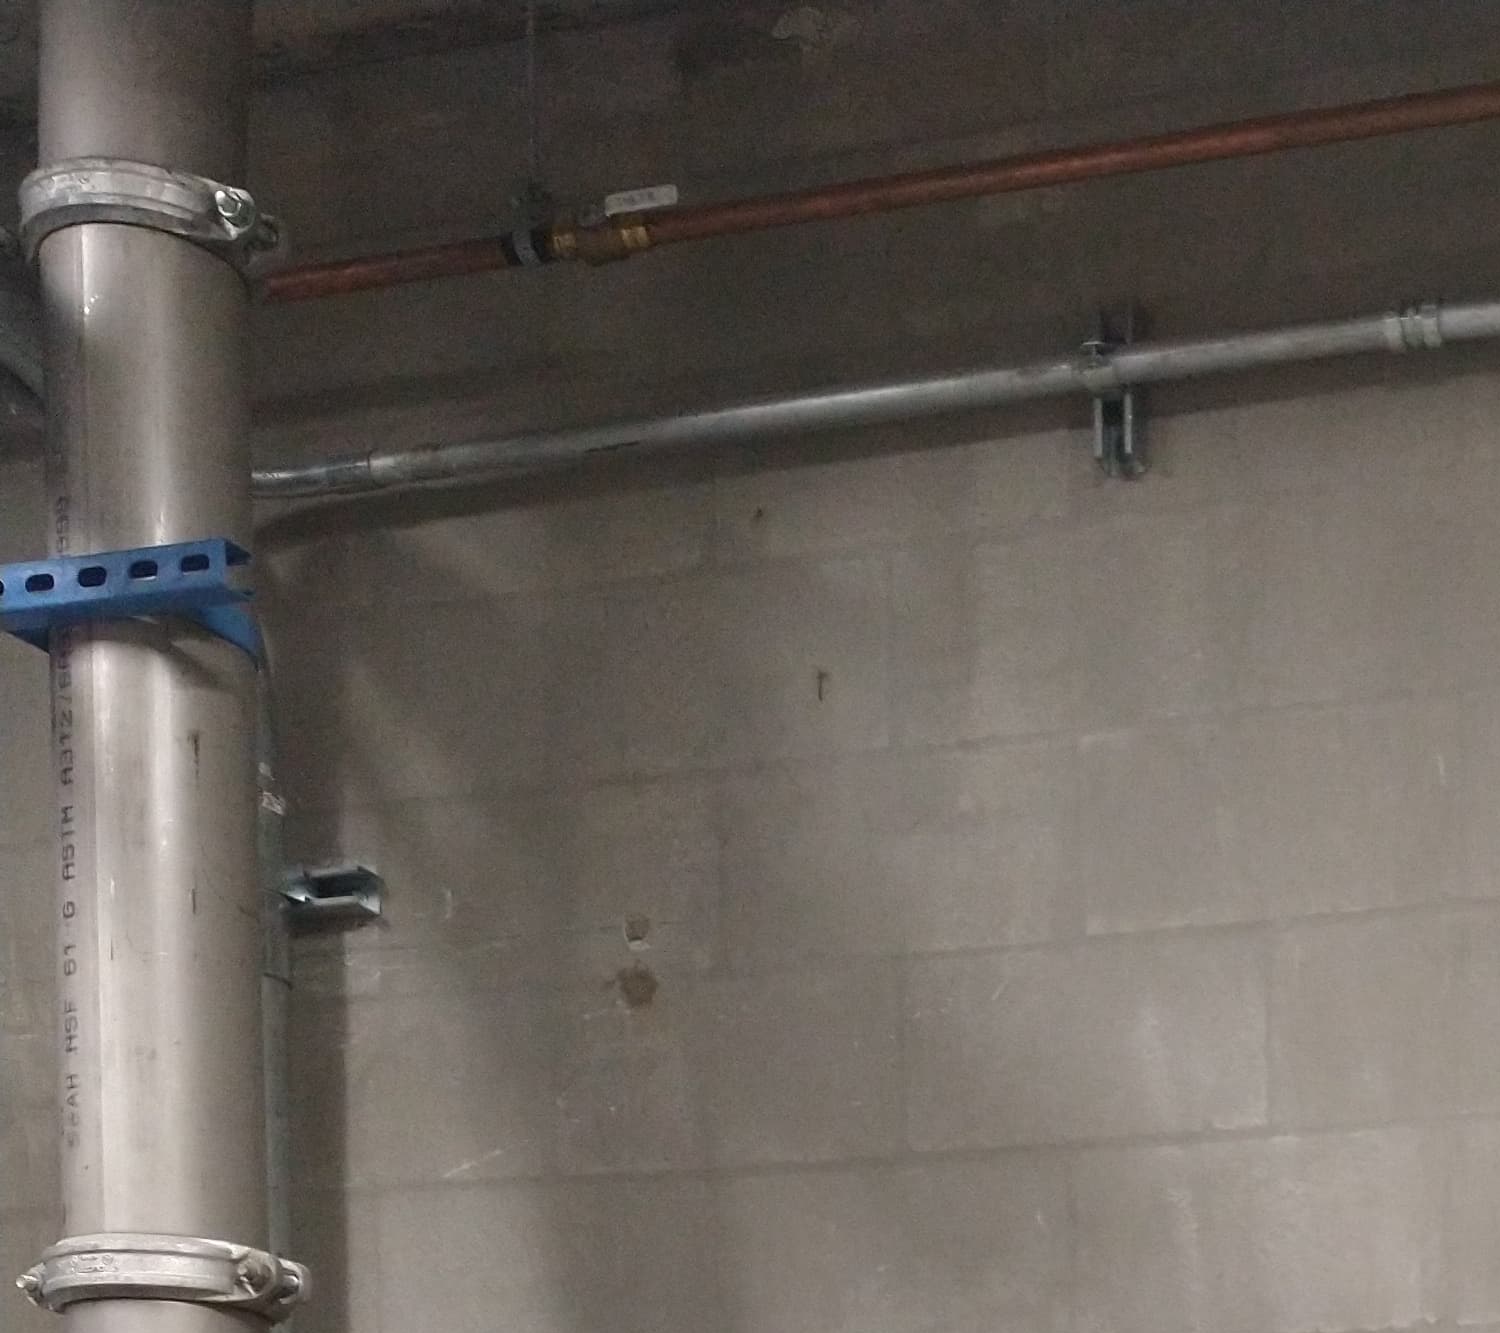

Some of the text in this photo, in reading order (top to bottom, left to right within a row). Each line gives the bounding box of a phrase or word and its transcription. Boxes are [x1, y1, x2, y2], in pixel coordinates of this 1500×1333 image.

[60, 803, 76, 882] ASTM
[61, 900, 76, 920] G
[61, 943, 77, 977] 61
